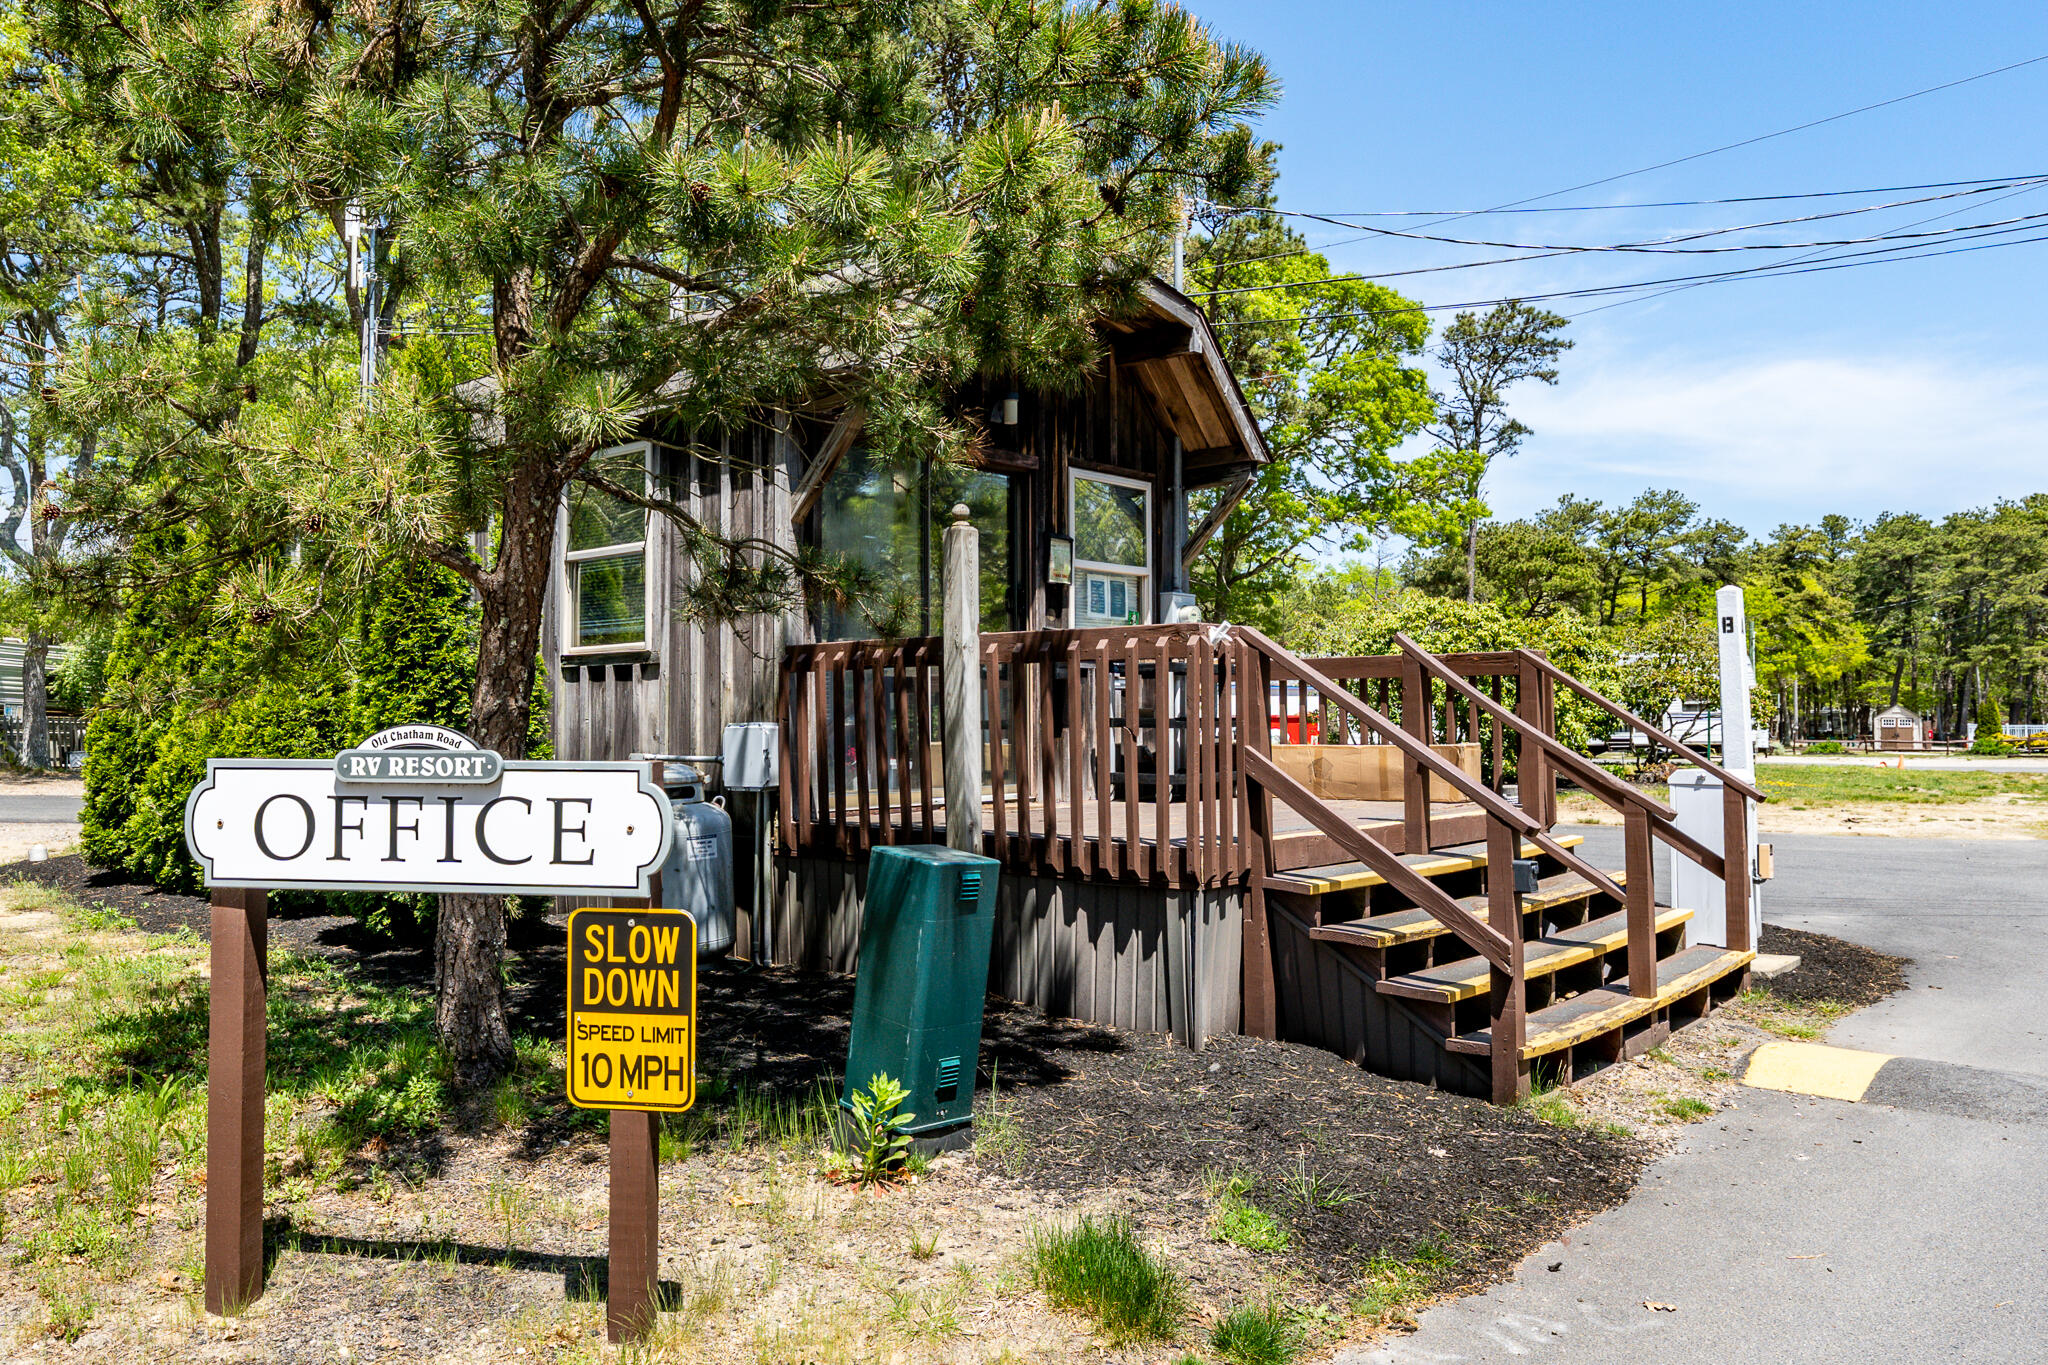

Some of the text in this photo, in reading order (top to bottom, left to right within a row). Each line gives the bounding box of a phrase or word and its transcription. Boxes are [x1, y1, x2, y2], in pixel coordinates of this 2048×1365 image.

[371, 730, 462, 748] Old Chatham Road
[350, 757, 486, 776] RV RESORT
[254, 794, 595, 865] OFFICE
[584, 924, 680, 964] SLOW
[584, 968, 679, 1008] DOWN
[577, 1024, 686, 1044] SPEED LIMIT
[581, 1052, 684, 1092] 10 MPH
